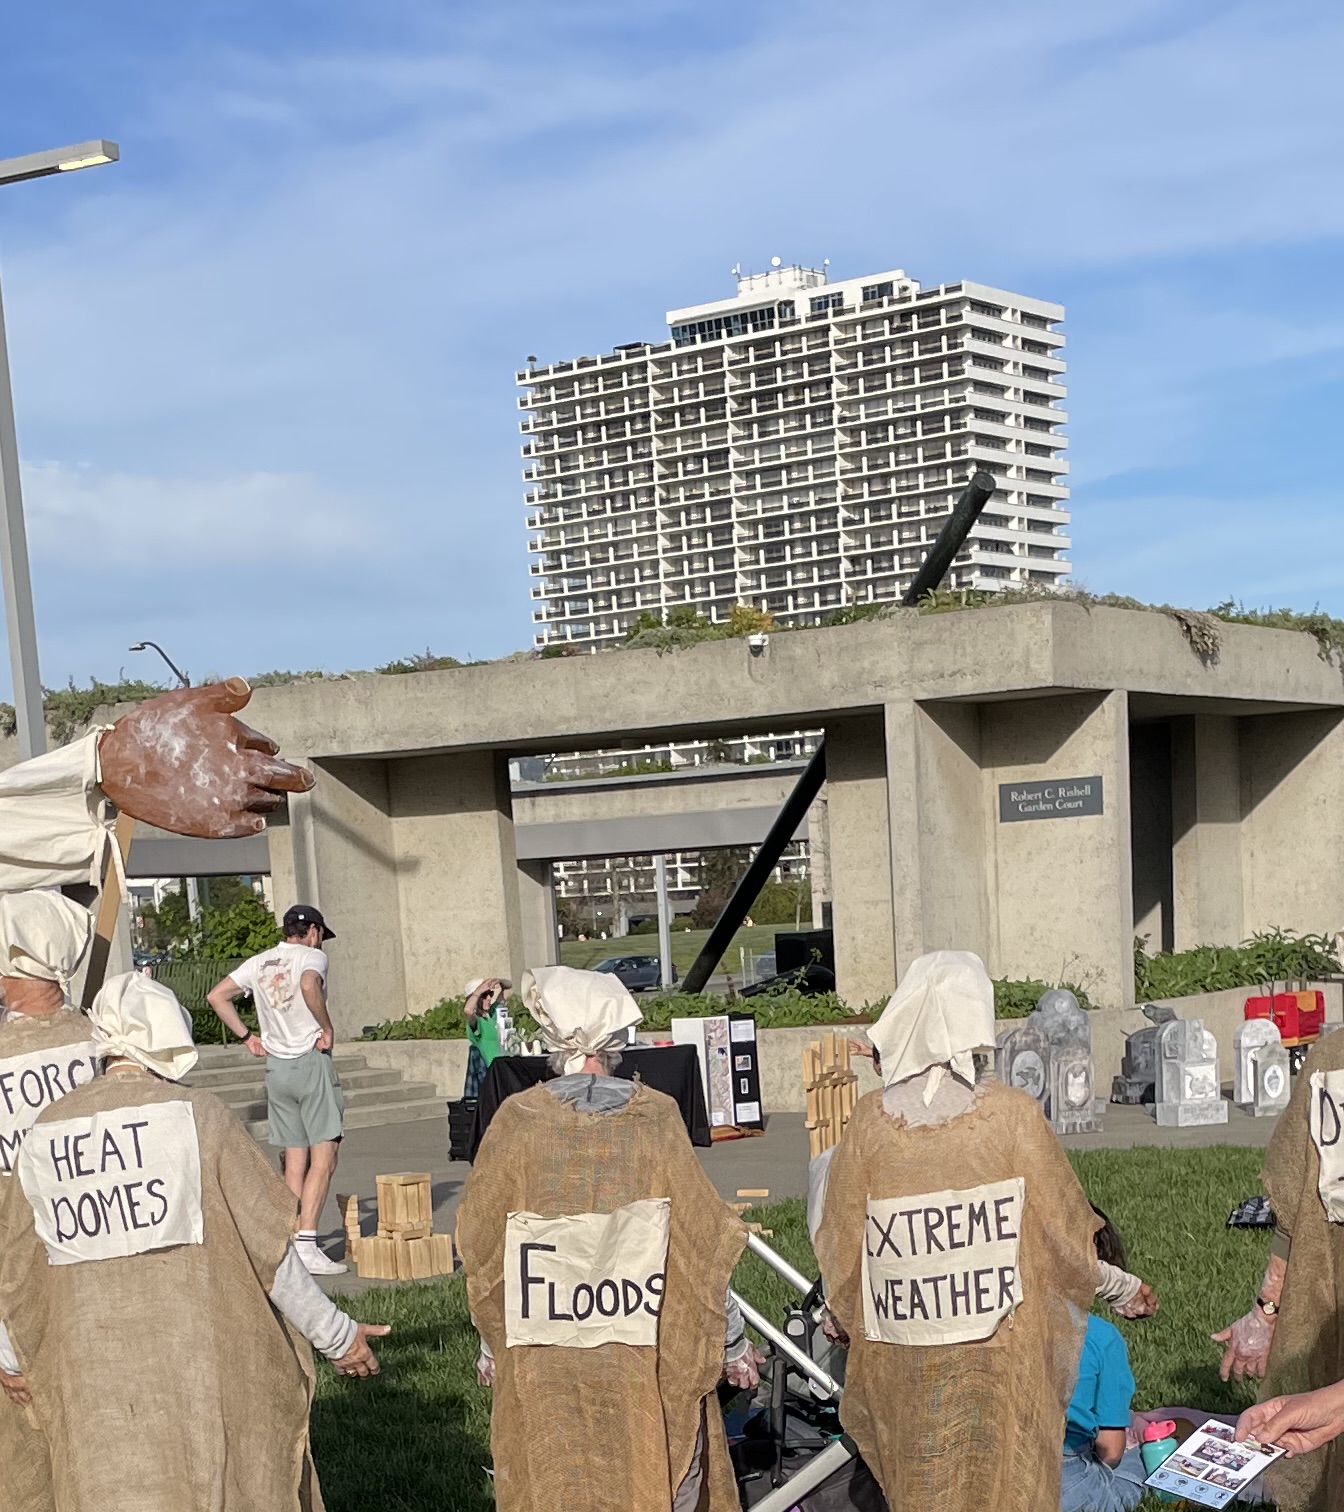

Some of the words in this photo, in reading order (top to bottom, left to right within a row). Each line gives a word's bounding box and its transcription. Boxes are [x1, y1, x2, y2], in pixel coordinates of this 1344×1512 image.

[1010, 789, 1042, 802] Robert
[1058, 784, 1091, 798] Rishell
[1018, 801, 1053, 813] Garden
[1056, 799, 1083, 810] Court
[50, 1121, 149, 1182] HEAT
[51, 1179, 168, 1243] DOMES
[869, 1266, 1015, 1321] WEATHER
